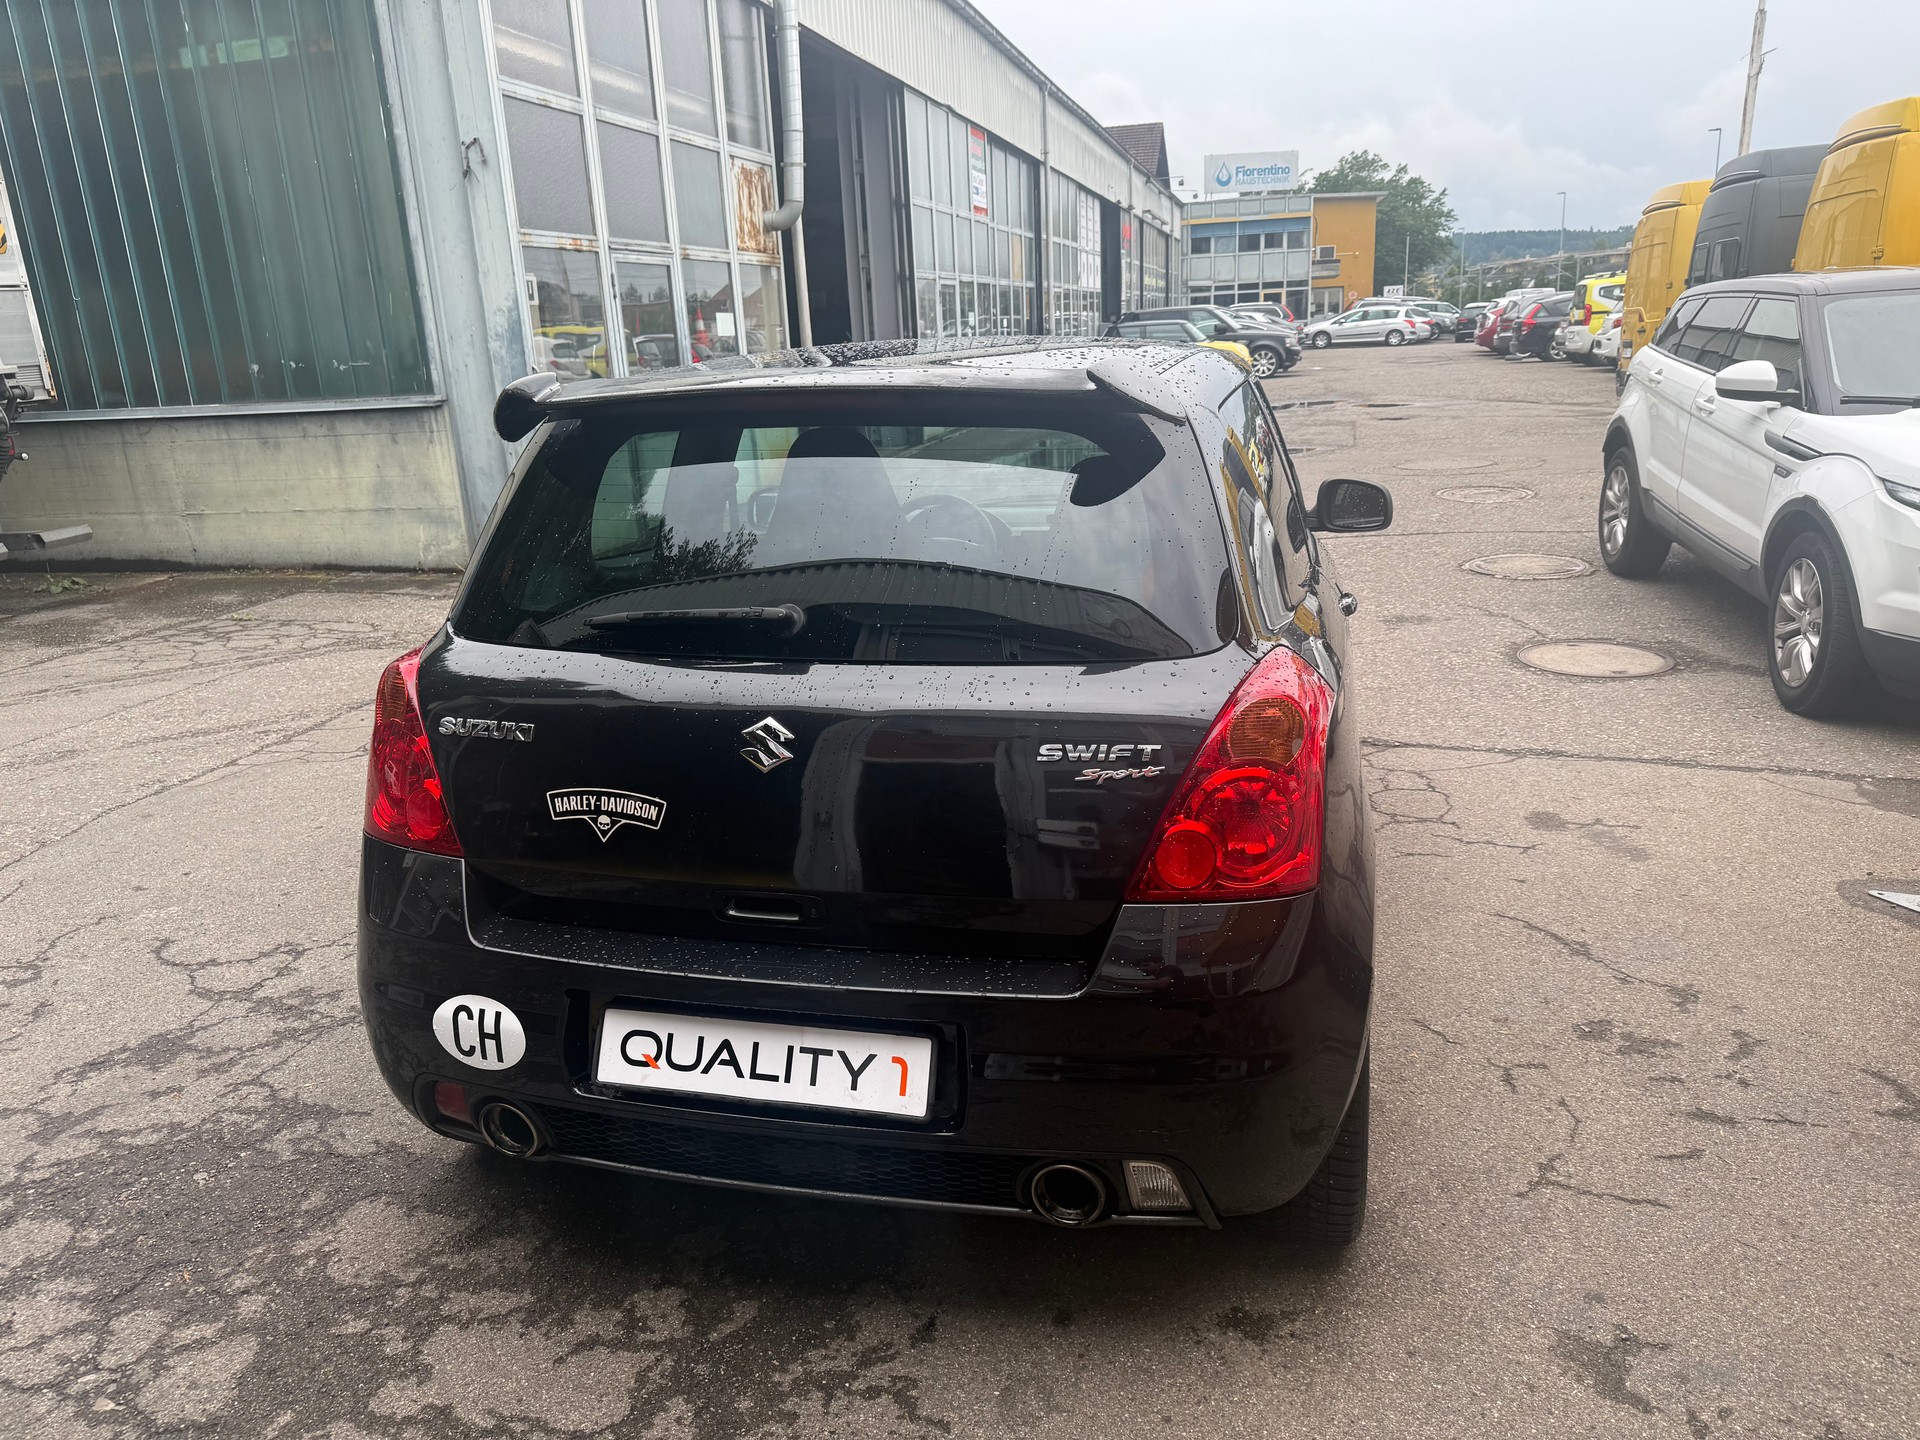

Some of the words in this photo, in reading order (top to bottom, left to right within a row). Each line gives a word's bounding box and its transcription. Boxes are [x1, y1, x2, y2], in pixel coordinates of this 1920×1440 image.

[1235, 163, 1291, 177] Fiorentino
[1235, 175, 1290, 186] HAUSTECHNIK
[438, 716, 535, 742] SUZUKI
[1036, 744, 1162, 762] SWIFT
[1074, 765, 1166, 786] Sport
[554, 794, 659, 821] HARLEY-DAVIDSON
[451, 1003, 504, 1064] CH
[619, 1029, 878, 1092] QUALITY
[891, 1056, 908, 1097] 1
